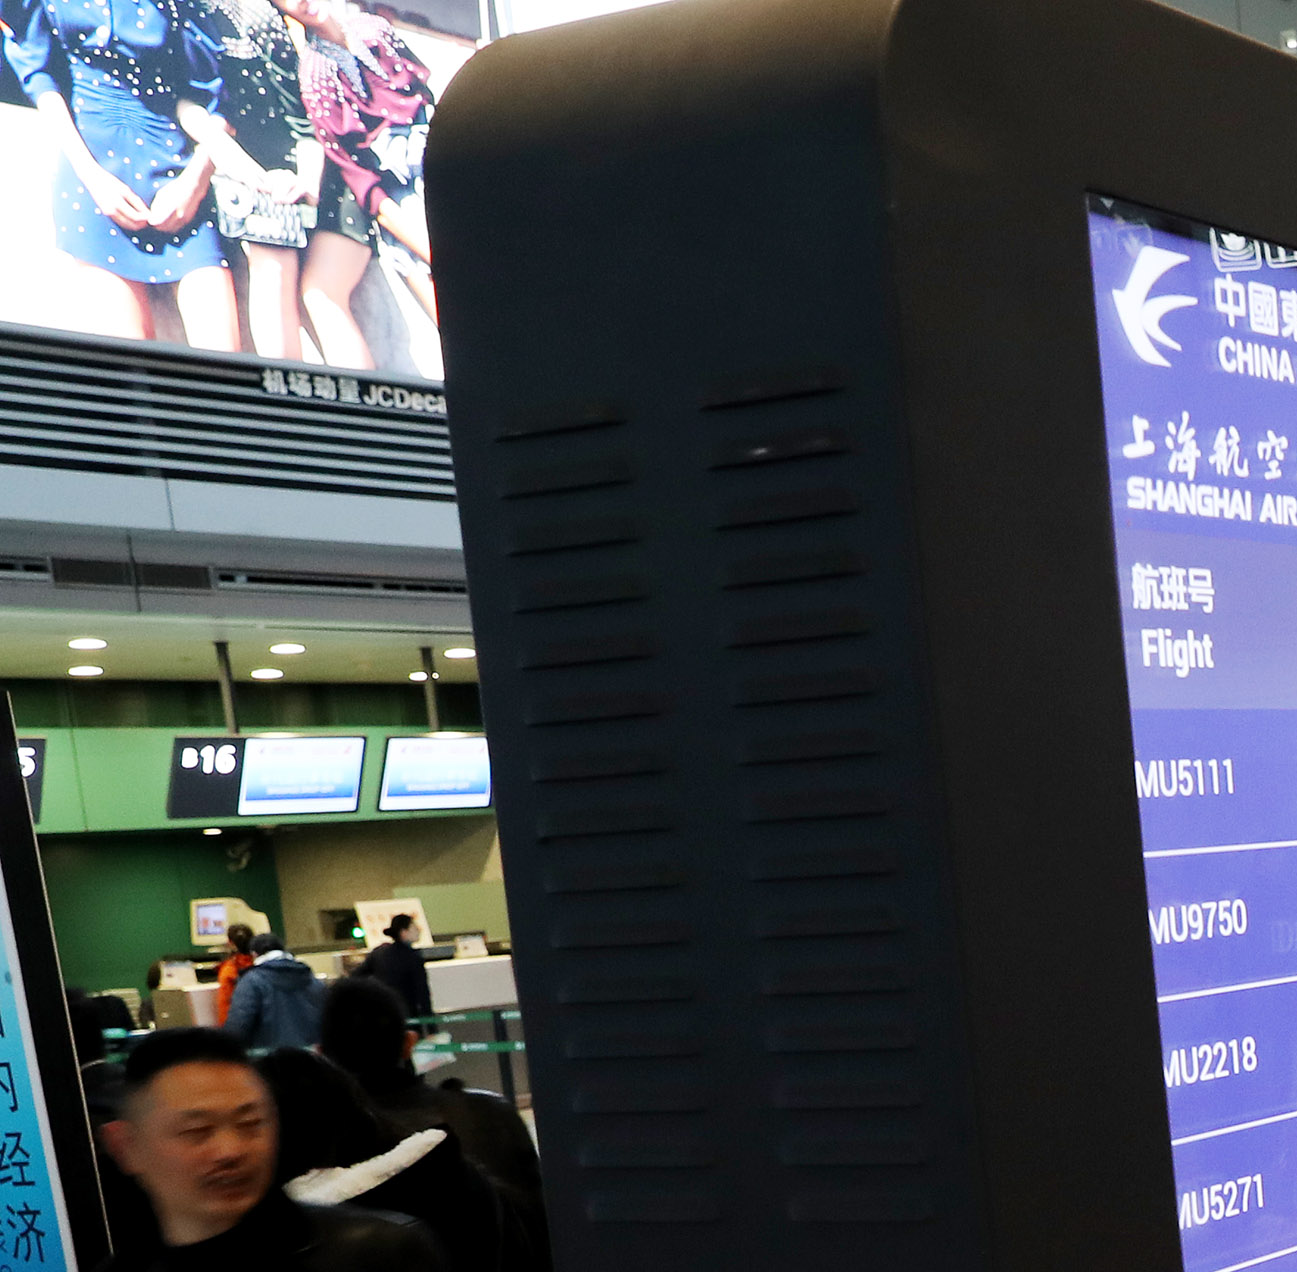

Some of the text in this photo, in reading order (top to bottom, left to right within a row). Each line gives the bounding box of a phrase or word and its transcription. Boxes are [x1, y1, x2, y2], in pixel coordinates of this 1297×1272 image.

[1218, 337, 1295, 384] CHINA
[1126, 476, 1252, 520] SHANGHAI
[1131, 562, 1215, 613] 航班号
[1141, 628, 1214, 678] Flight
[181, 744, 237, 776] B16
[1135, 759, 1234, 798] MU5111
[1149, 899, 1247, 945] MU9750
[1164, 1036, 1257, 1087] MU2218
